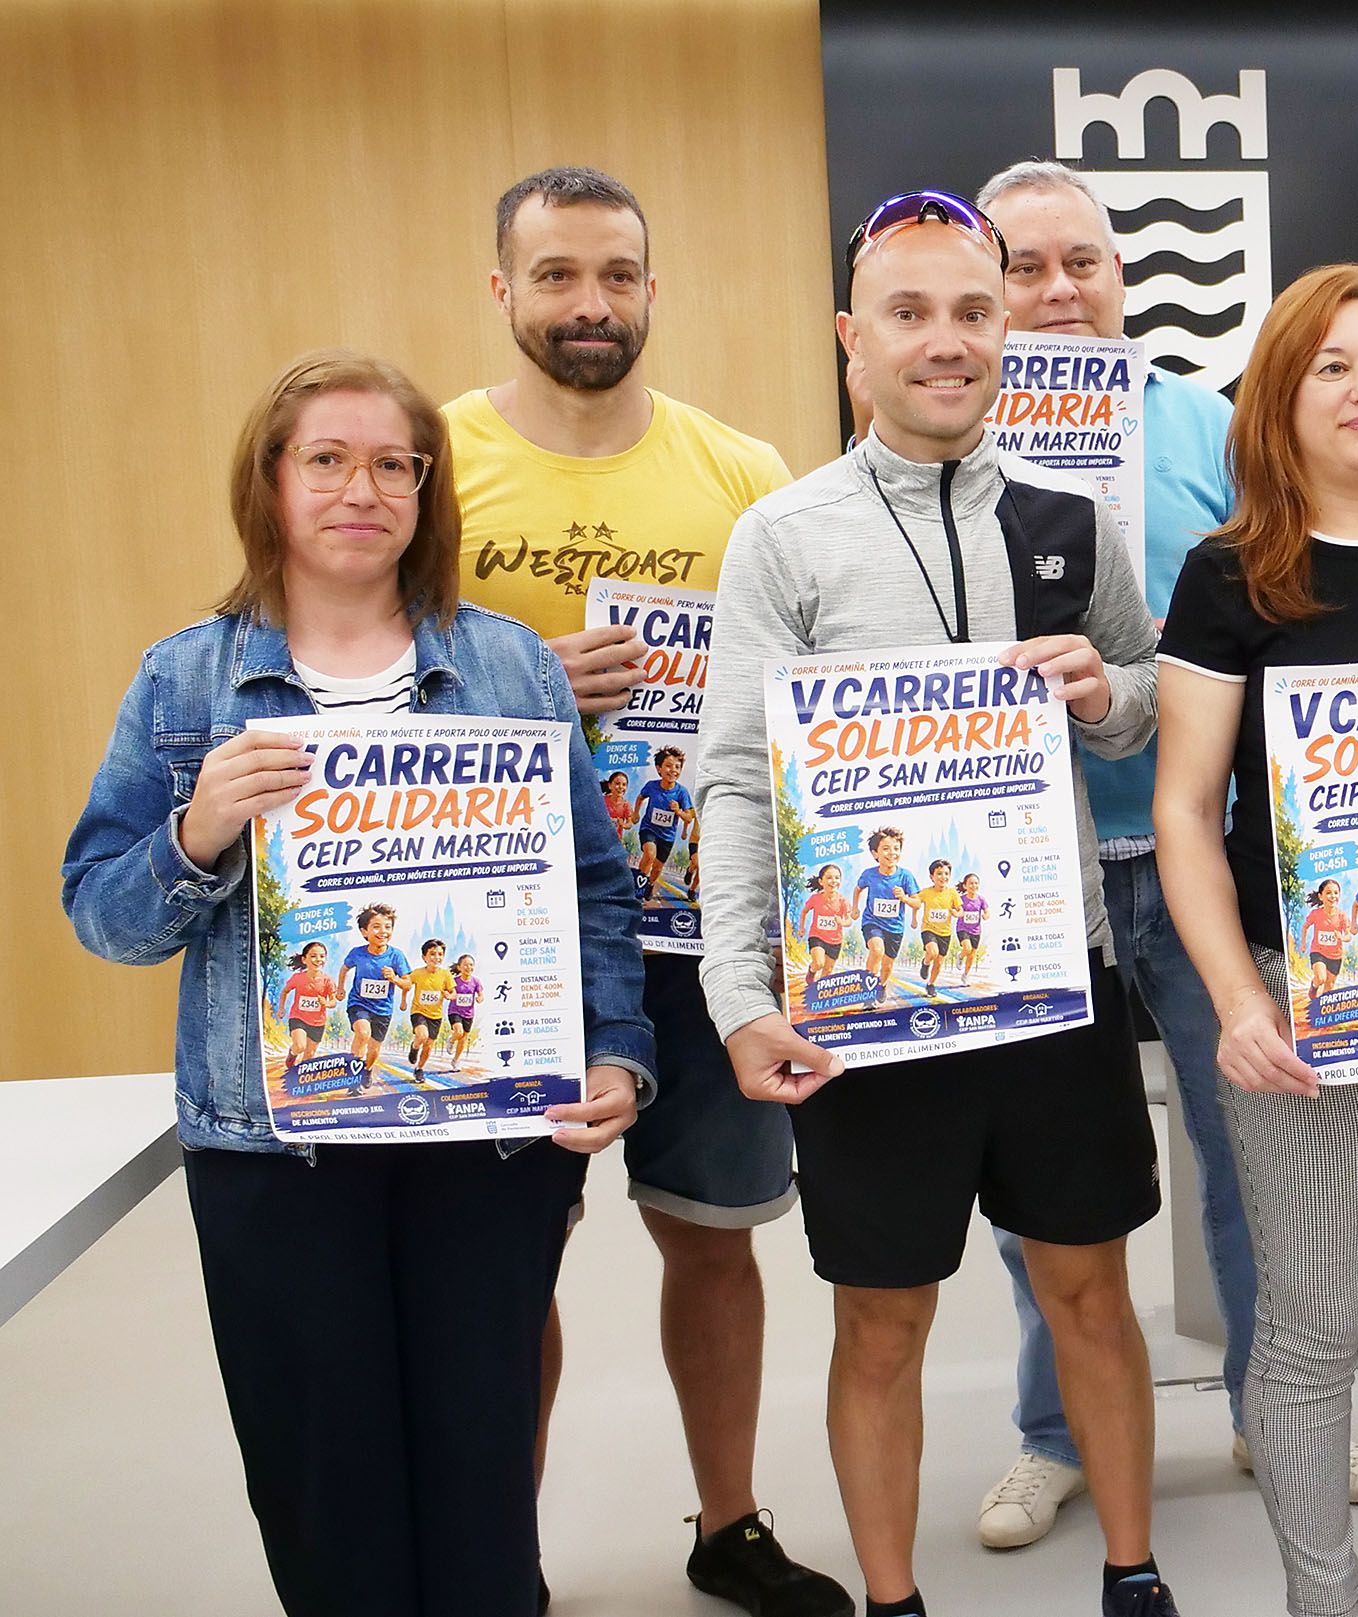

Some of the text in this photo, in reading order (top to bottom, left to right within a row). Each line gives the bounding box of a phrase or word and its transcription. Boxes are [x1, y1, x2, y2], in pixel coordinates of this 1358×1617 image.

[1082, 346, 1094, 354] QUE
[1000, 355, 1131, 392] RREIRA
[984, 392, 1113, 428] IDARIA
[996, 428, 1121, 451] AN MARTIÑO
[1101, 483, 1109, 494] 5
[475, 535, 706, 584] WESTCOAST
[612, 592, 715, 611] CORRE OU CAMIÑA, PERO MÓVE
[791, 665, 818, 675] CORRE
[820, 664, 833, 673] OU
[834, 662, 867, 672] CAMIÑA,
[869, 662, 891, 671] PERO
[892, 659, 924, 670] MÓVETE
[927, 660, 932, 668] E
[932, 658, 964, 668] APORTA
[1290, 678, 1316, 688] CORRE
[790, 666, 1048, 724] V CARREIRA
[1289, 692, 1323, 739] V
[312, 729, 326, 737] OU
[327, 728, 363, 738] CAMIÑA,
[365, 729, 388, 738] PERO
[390, 727, 424, 737] MÓVETE
[427, 729, 432, 737] E
[433, 729, 466, 737] APORTA
[468, 729, 490, 737] POLO
[492, 729, 509, 737] QUE
[510, 729, 547, 737] IMPORTA
[804, 710, 1033, 768] SOLIDARIA
[324, 742, 554, 789] CARREIRA
[608, 753, 639, 764] 10:45h
[811, 749, 1045, 797] CEIP SAN MARTIÑO
[290, 787, 534, 839] SOLIDARIA
[655, 812, 672, 822] 1234
[810, 831, 847, 846] DENDE AS
[297, 827, 547, 870] CEIP SAN MARTIÑO
[814, 841, 850, 858] 10:45h
[1309, 847, 1345, 860] DENDE AS
[1313, 857, 1348, 872] 10:45h
[317, 862, 538, 888] CORRE OU CAMIÑA, PERO MÓVETE E APORTA POLO QUE IMPORTA
[523, 893, 533, 906] 5
[294, 907, 335, 921] DENDE AS
[877, 903, 898, 913] 1234
[298, 918, 337, 935] 10:45h
[530, 918, 550, 926] 2026
[819, 919, 837, 927] 2345
[1319, 934, 1337, 942] 2345
[519, 946, 556, 956] CEIP SAN
[668, 942, 704, 950] ALIMENTO
[519, 955, 557, 966] MARTIÑO
[520, 975, 558, 983] DISTANCIAS
[364, 984, 387, 994] 1234
[300, 999, 320, 1008] 2345
[523, 1048, 557, 1057] PETISCOS
[298, 1068, 348, 1084] COLABORA,
[1325, 1069, 1346, 1080] PROL
[292, 1085, 305, 1096] FAI
[314, 1075, 363, 1091] DIFERENCIA!
